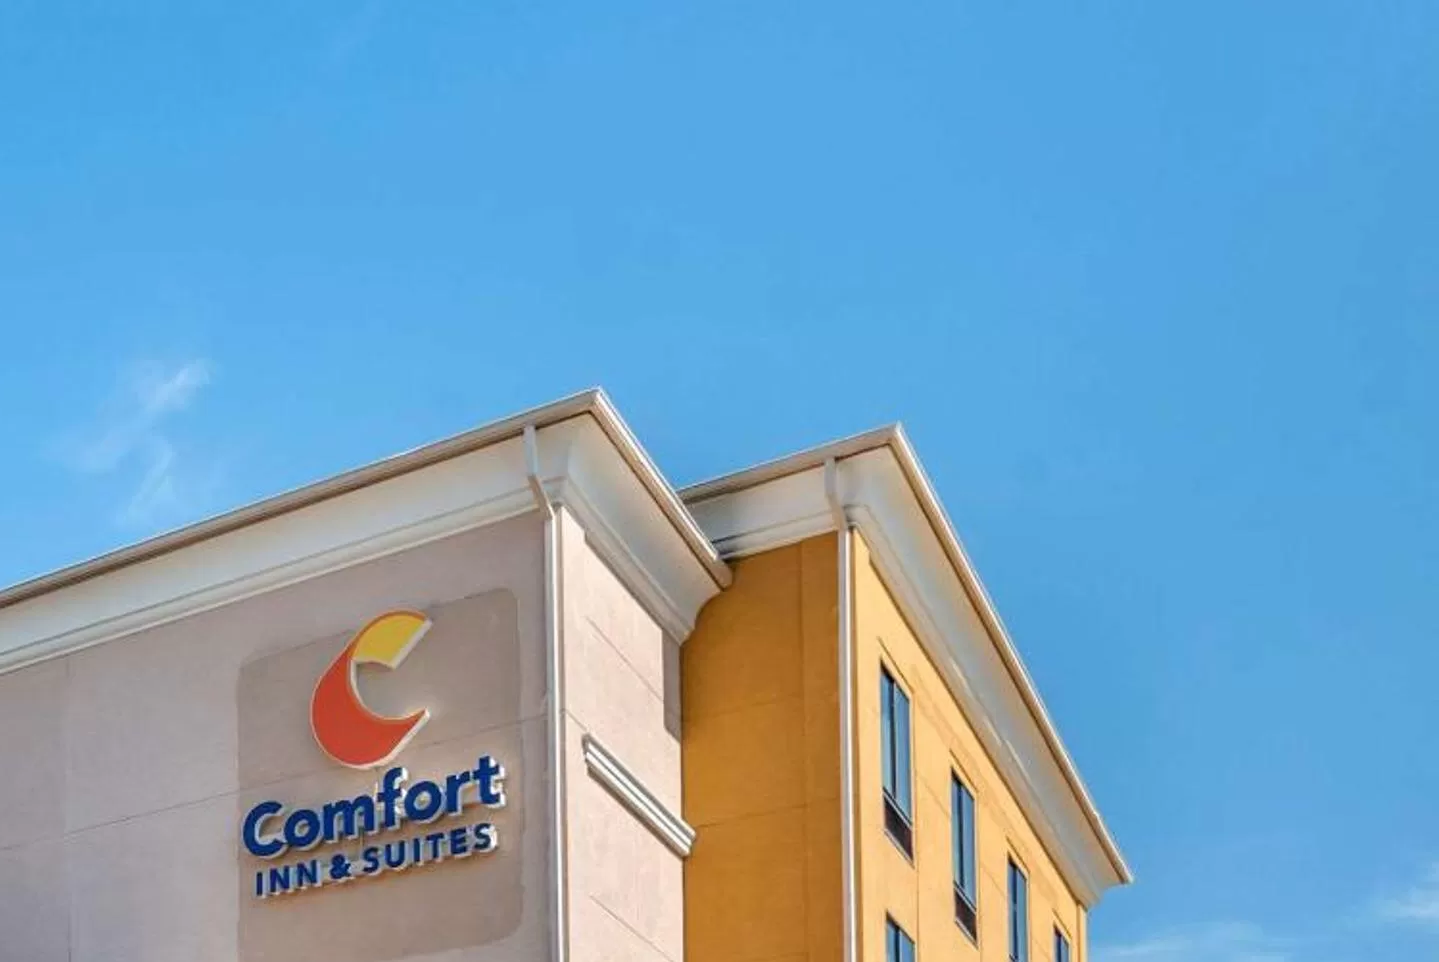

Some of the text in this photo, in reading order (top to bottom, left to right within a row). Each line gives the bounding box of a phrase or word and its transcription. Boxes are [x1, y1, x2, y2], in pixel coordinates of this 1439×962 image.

[242, 755, 505, 858] Comfort
[255, 822, 497, 898] INN & SUITES
